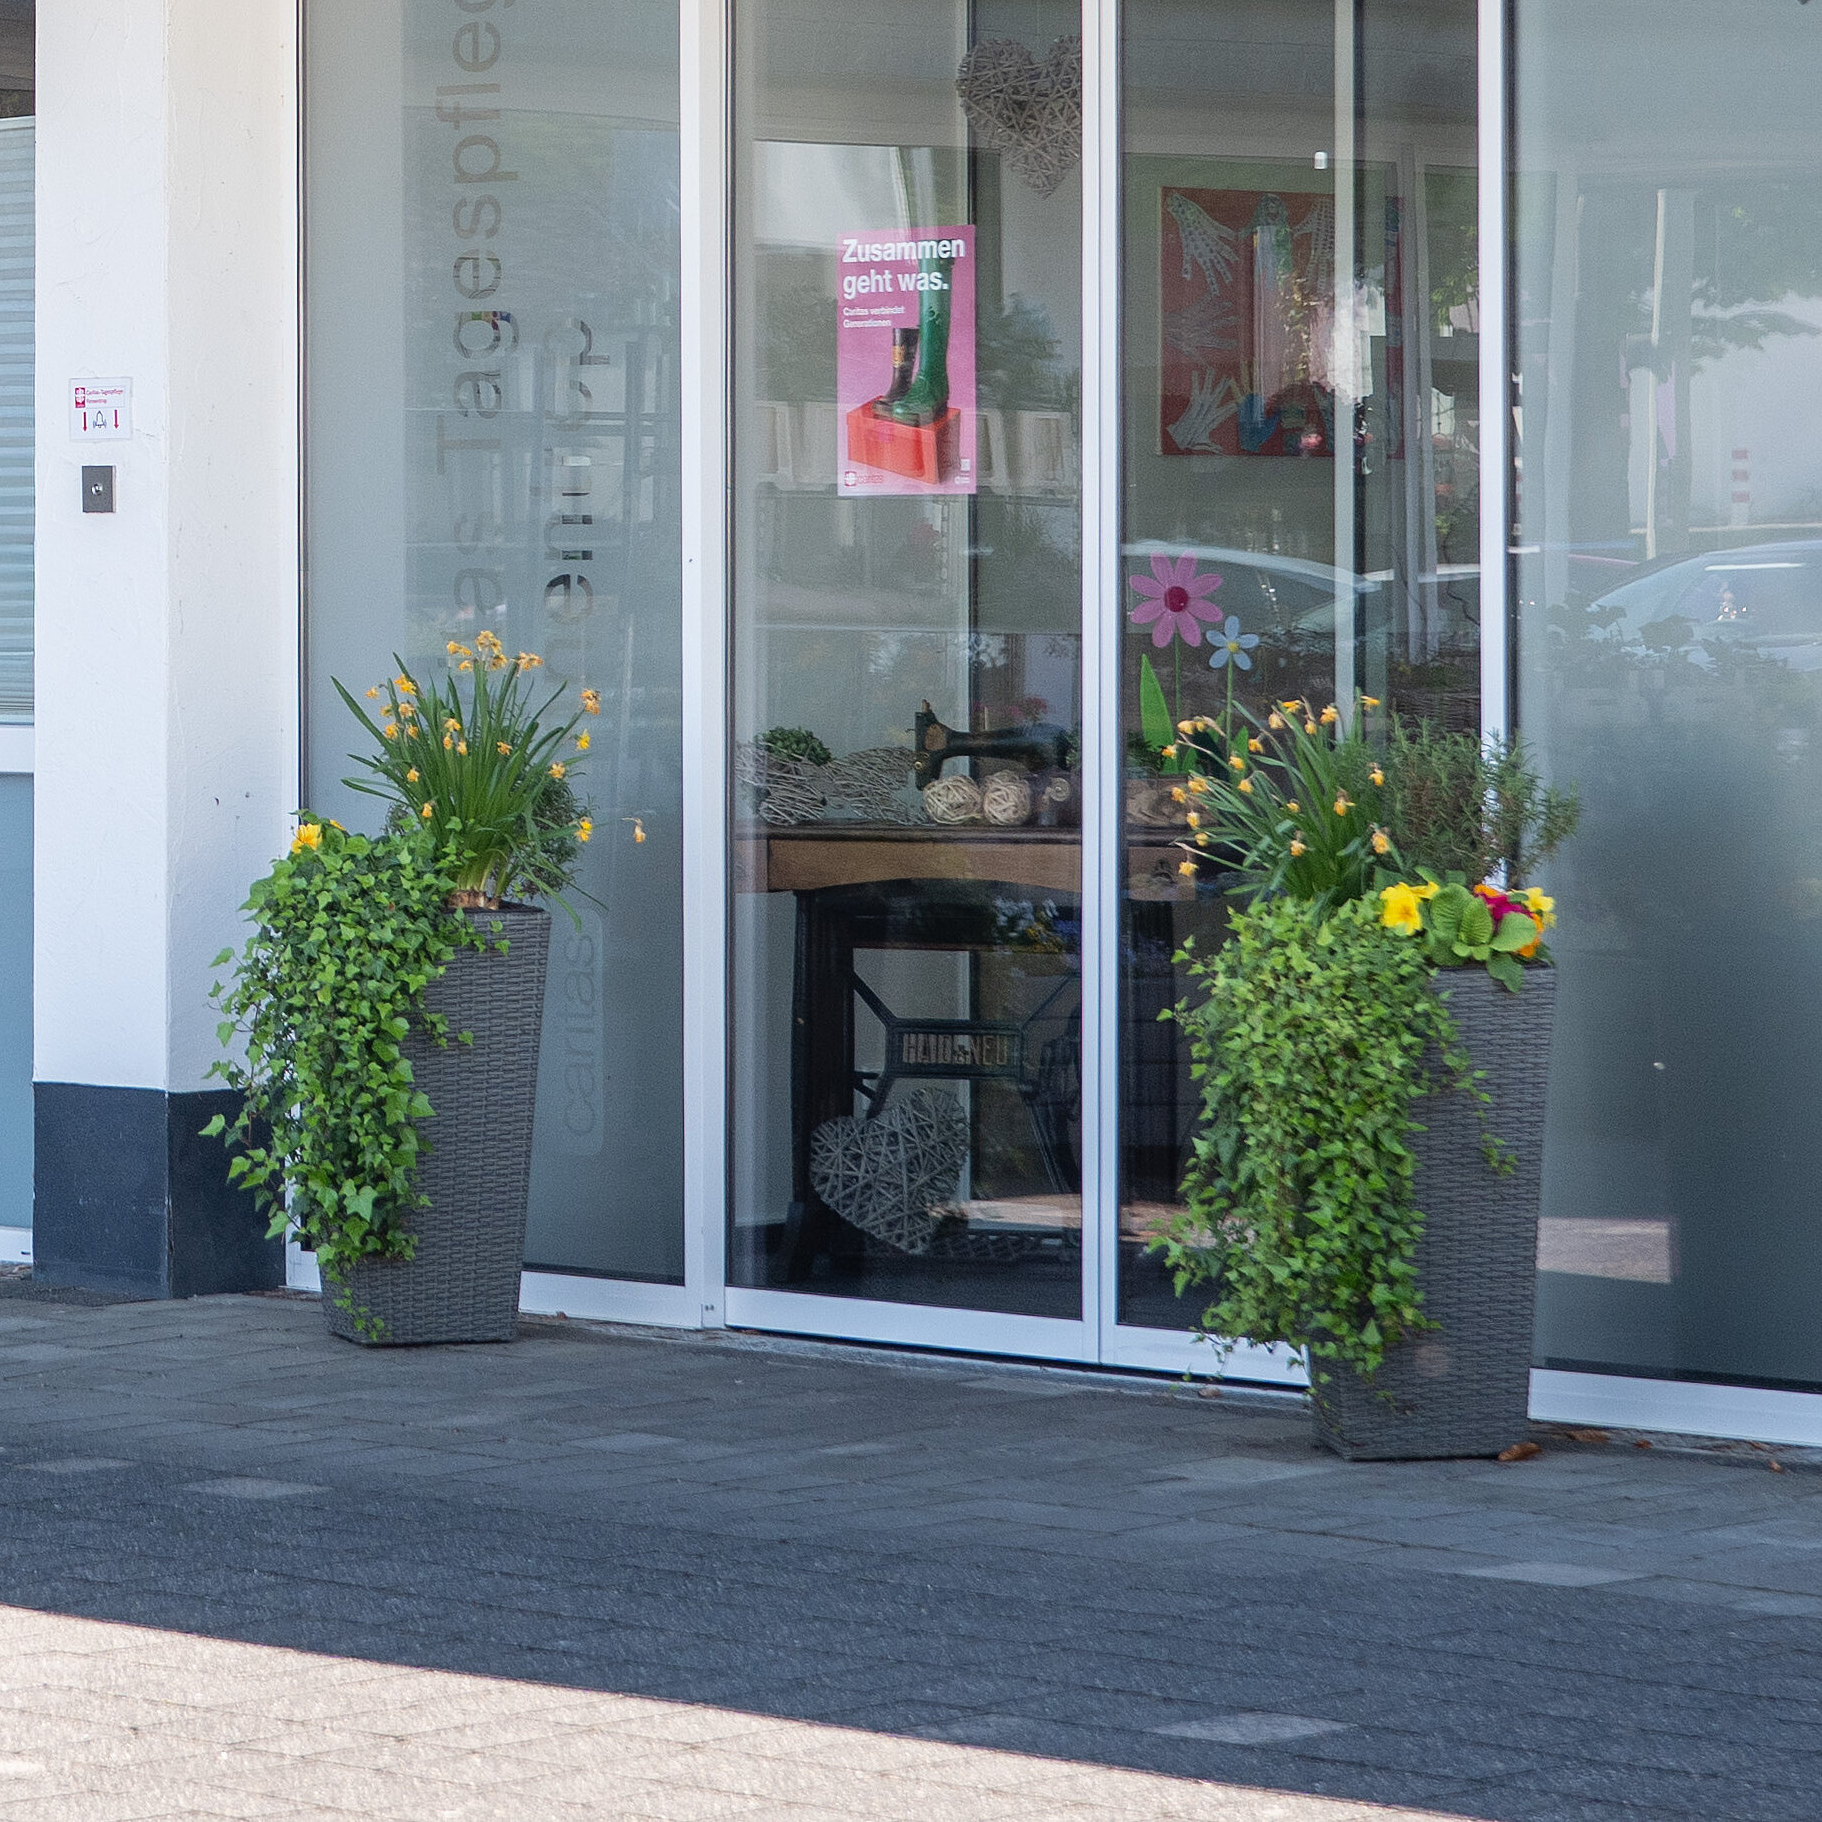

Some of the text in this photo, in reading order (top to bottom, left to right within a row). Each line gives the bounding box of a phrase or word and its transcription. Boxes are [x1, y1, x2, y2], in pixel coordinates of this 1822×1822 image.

[842, 238, 966, 263] Zusammen
[843, 269, 950, 300] geht was.
